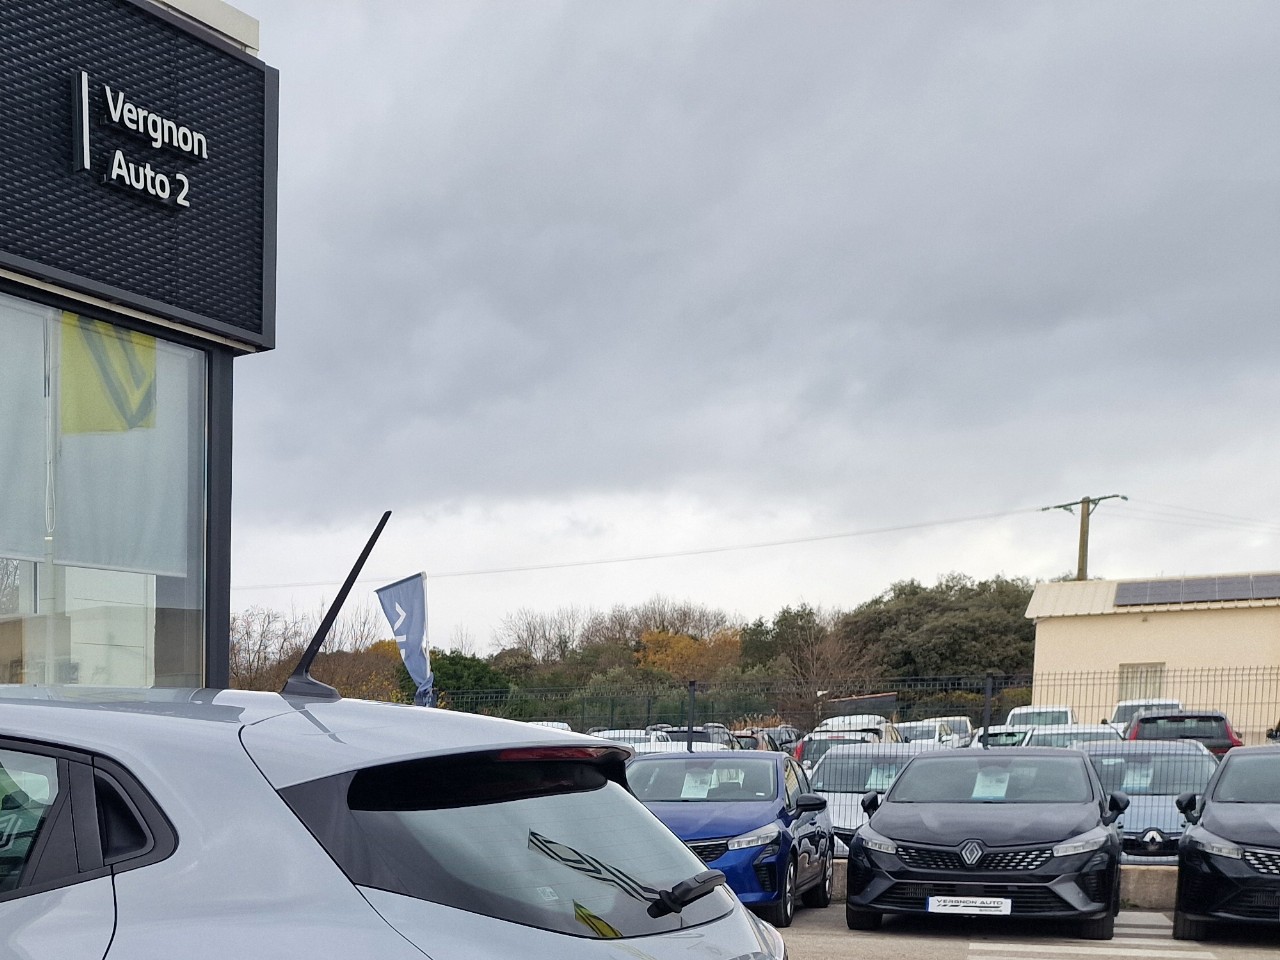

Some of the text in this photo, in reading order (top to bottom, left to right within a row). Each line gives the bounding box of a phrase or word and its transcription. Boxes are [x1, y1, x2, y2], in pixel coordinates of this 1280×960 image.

[104, 84, 209, 160] Vergnon
[111, 149, 191, 208] Auto 2
